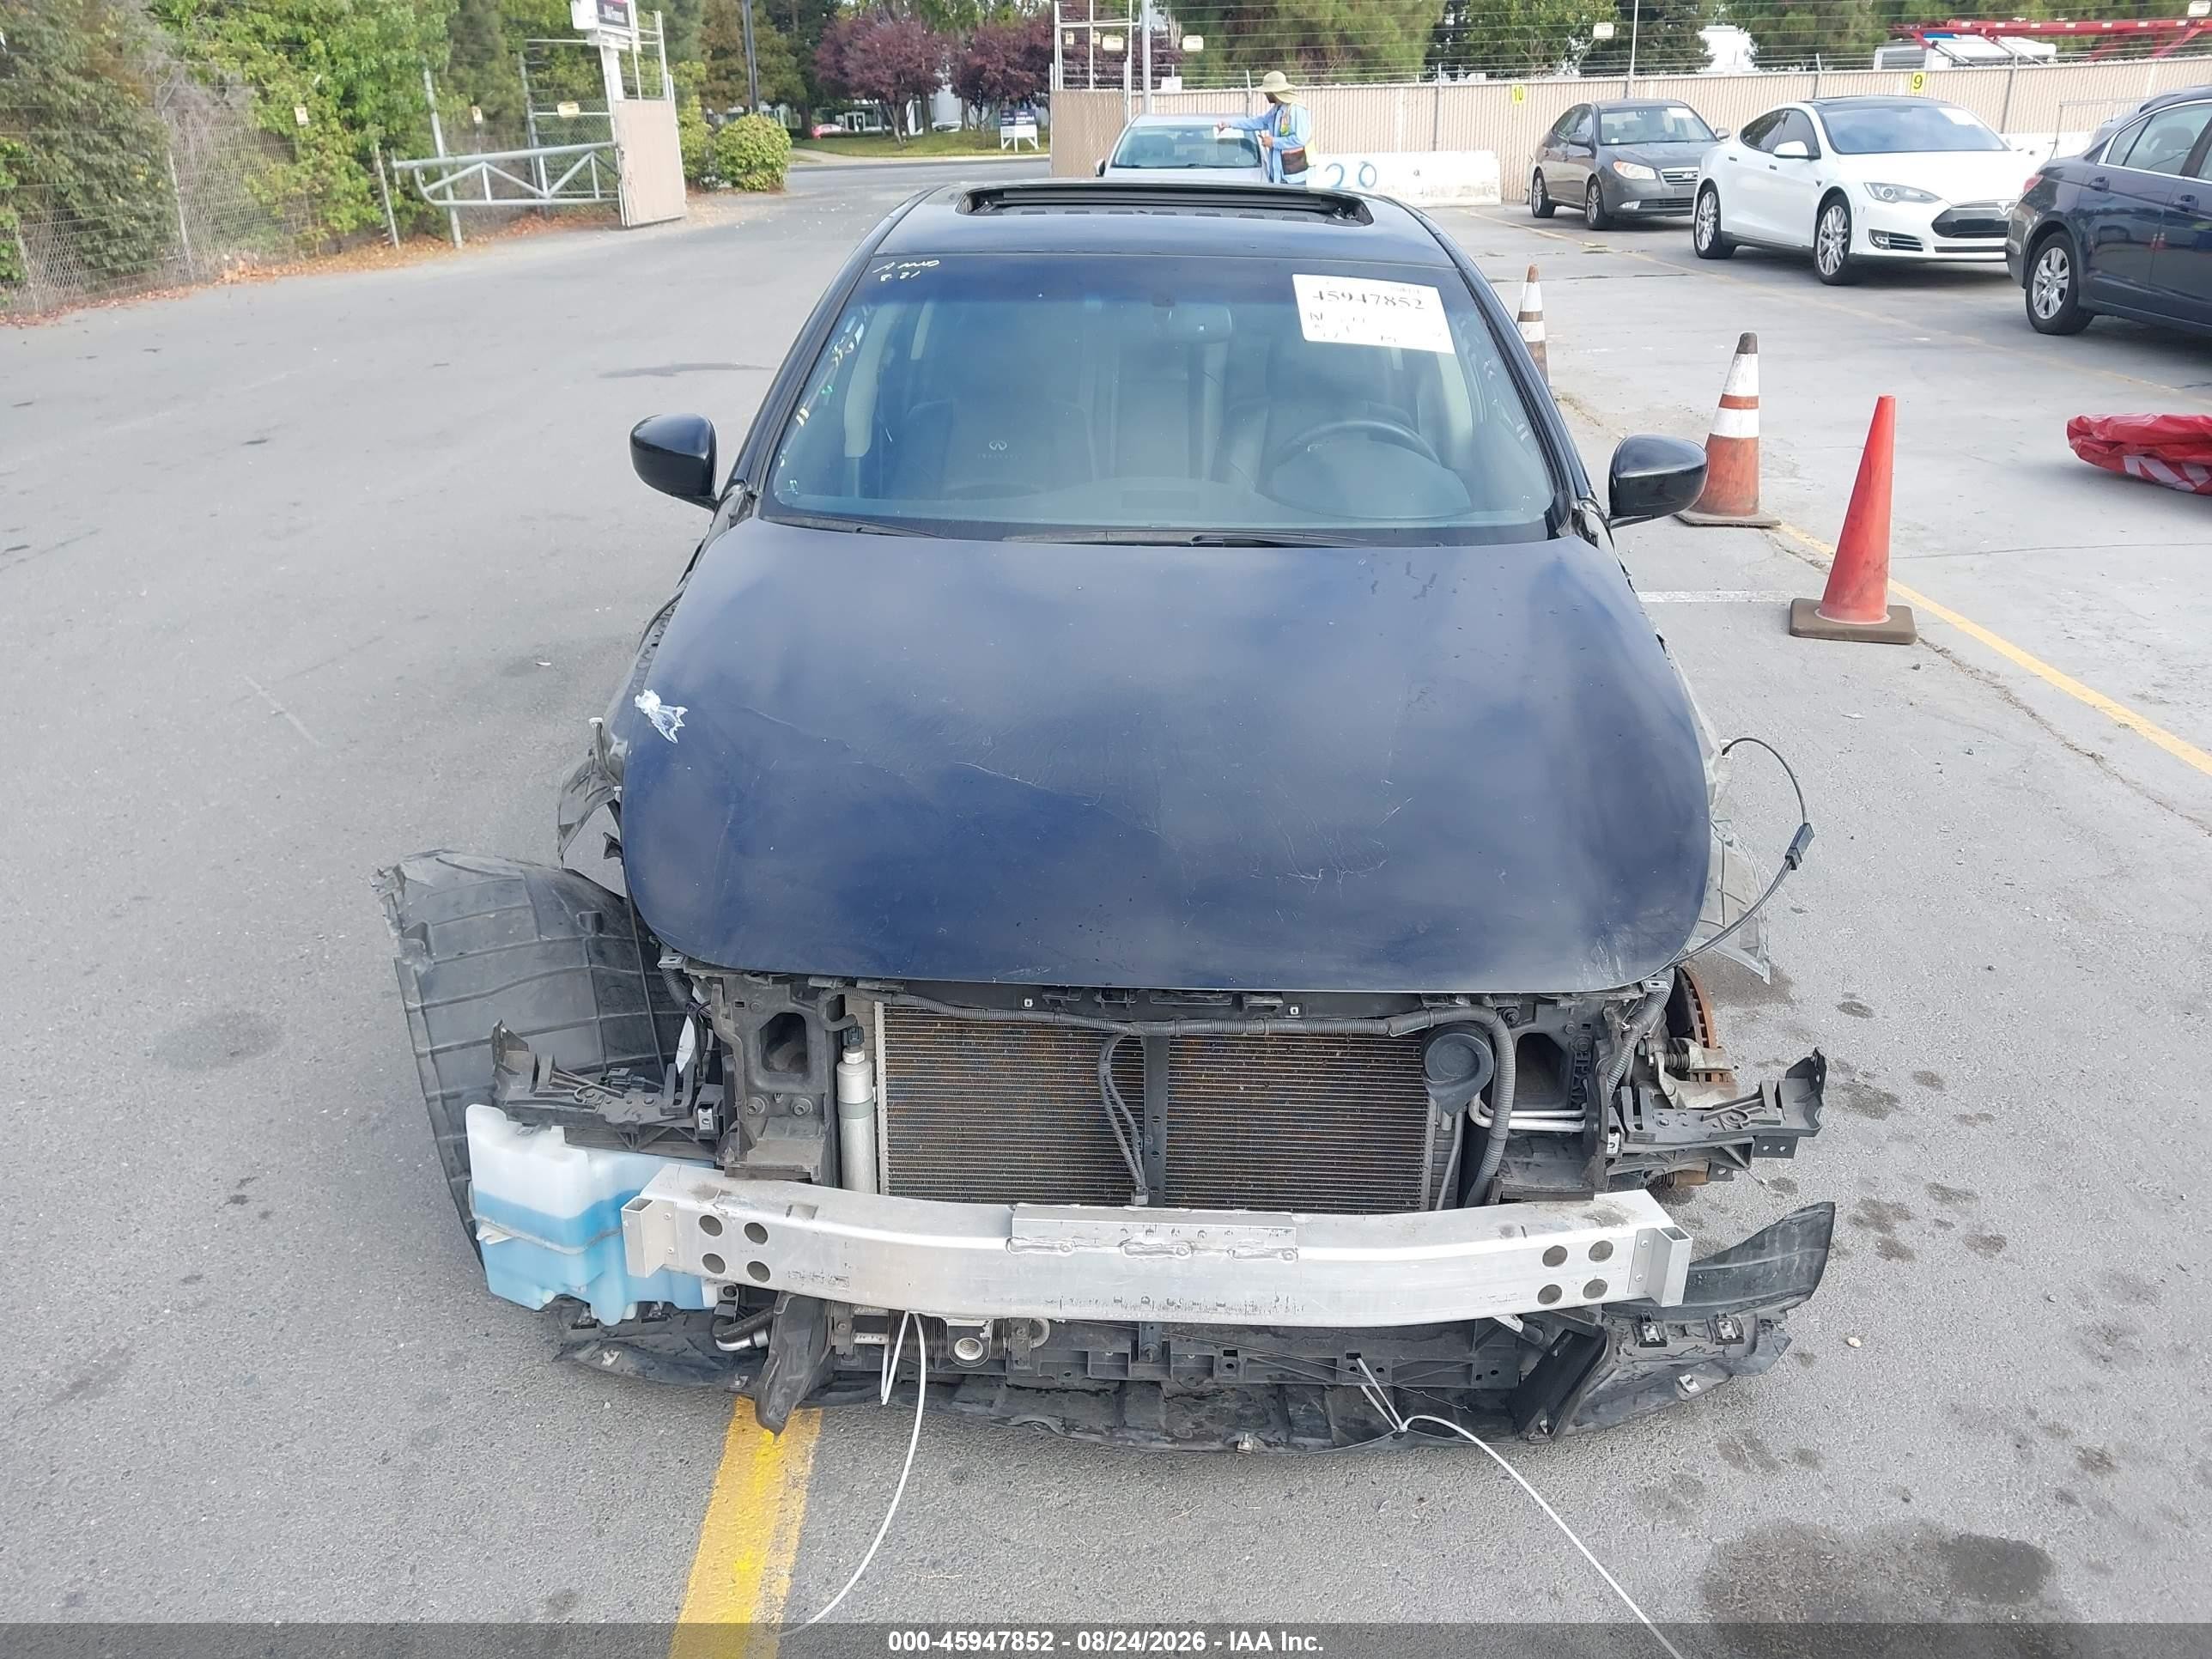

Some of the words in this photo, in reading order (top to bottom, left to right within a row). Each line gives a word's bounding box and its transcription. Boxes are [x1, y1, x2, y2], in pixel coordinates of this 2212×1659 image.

[1913, 75, 1923, 89] 9
[1513, 85, 1523, 101] 10
[1311, 290, 1425, 310] 45947852
